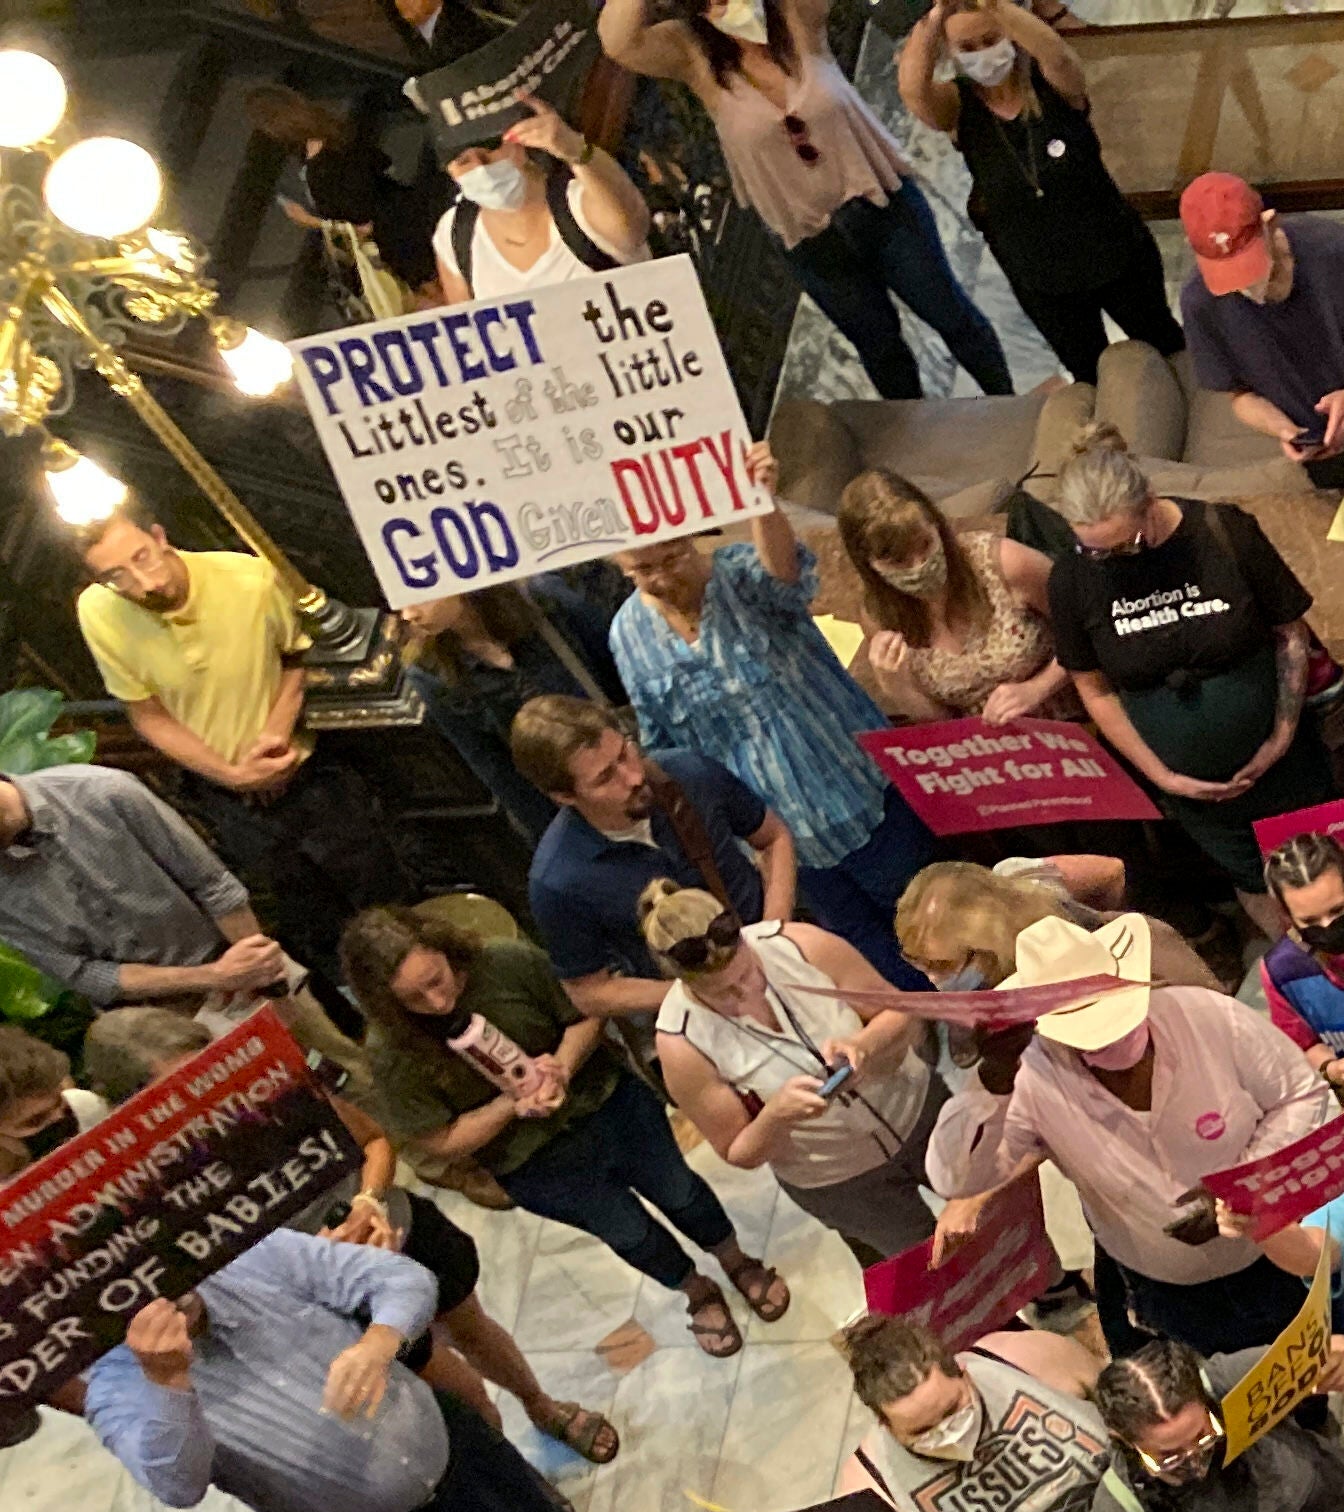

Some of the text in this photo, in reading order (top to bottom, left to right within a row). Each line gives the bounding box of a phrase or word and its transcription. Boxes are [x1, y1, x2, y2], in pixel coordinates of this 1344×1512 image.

[301, 282, 674, 416] PROTECT the
[337, 391, 499, 458] Littlest
[599, 339, 703, 398] little
[374, 458, 487, 504] ones.
[567, 425, 603, 465] is
[614, 407, 684, 446] our
[380, 500, 520, 589] GOD
[1111, 583, 1200, 618] Abortion is
[1114, 598, 1231, 637] Health Care.
[884, 730, 1090, 767] Together We
[915, 757, 1106, 795] Fight for All
[105, 1126, 139, 1156] IN
[139, 1096, 187, 1131] THE
[20, 1216, 161, 1322] FUNDING
[162, 1161, 233, 1209] THE
[100, 1255, 167, 1313] OF
[175, 1129, 345, 1261] BABIES!
[1247, 1319, 1318, 1408] BANS
